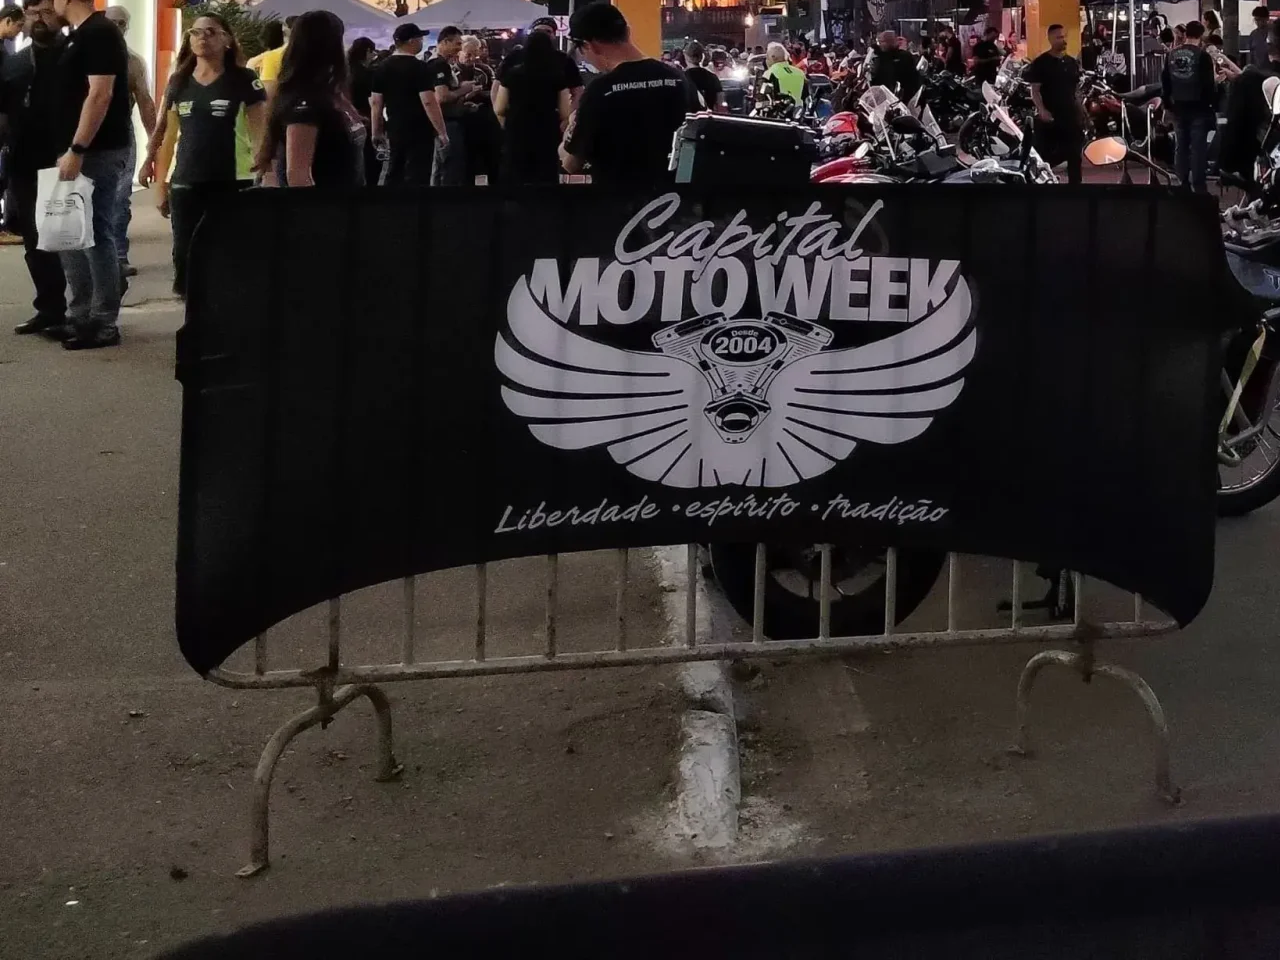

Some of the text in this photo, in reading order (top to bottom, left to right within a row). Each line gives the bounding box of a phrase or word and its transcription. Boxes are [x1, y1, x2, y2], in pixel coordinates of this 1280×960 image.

[612, 80, 647, 92] REIMAGINE
[647, 79, 663, 88] YOUR
[614, 192, 885, 279] Capital
[530, 255, 961, 326] MOTO WEEK
[714, 336, 773, 354] 2004
[731, 329, 759, 338] Desde
[494, 493, 949, 535] Liberdade espírito tradição
